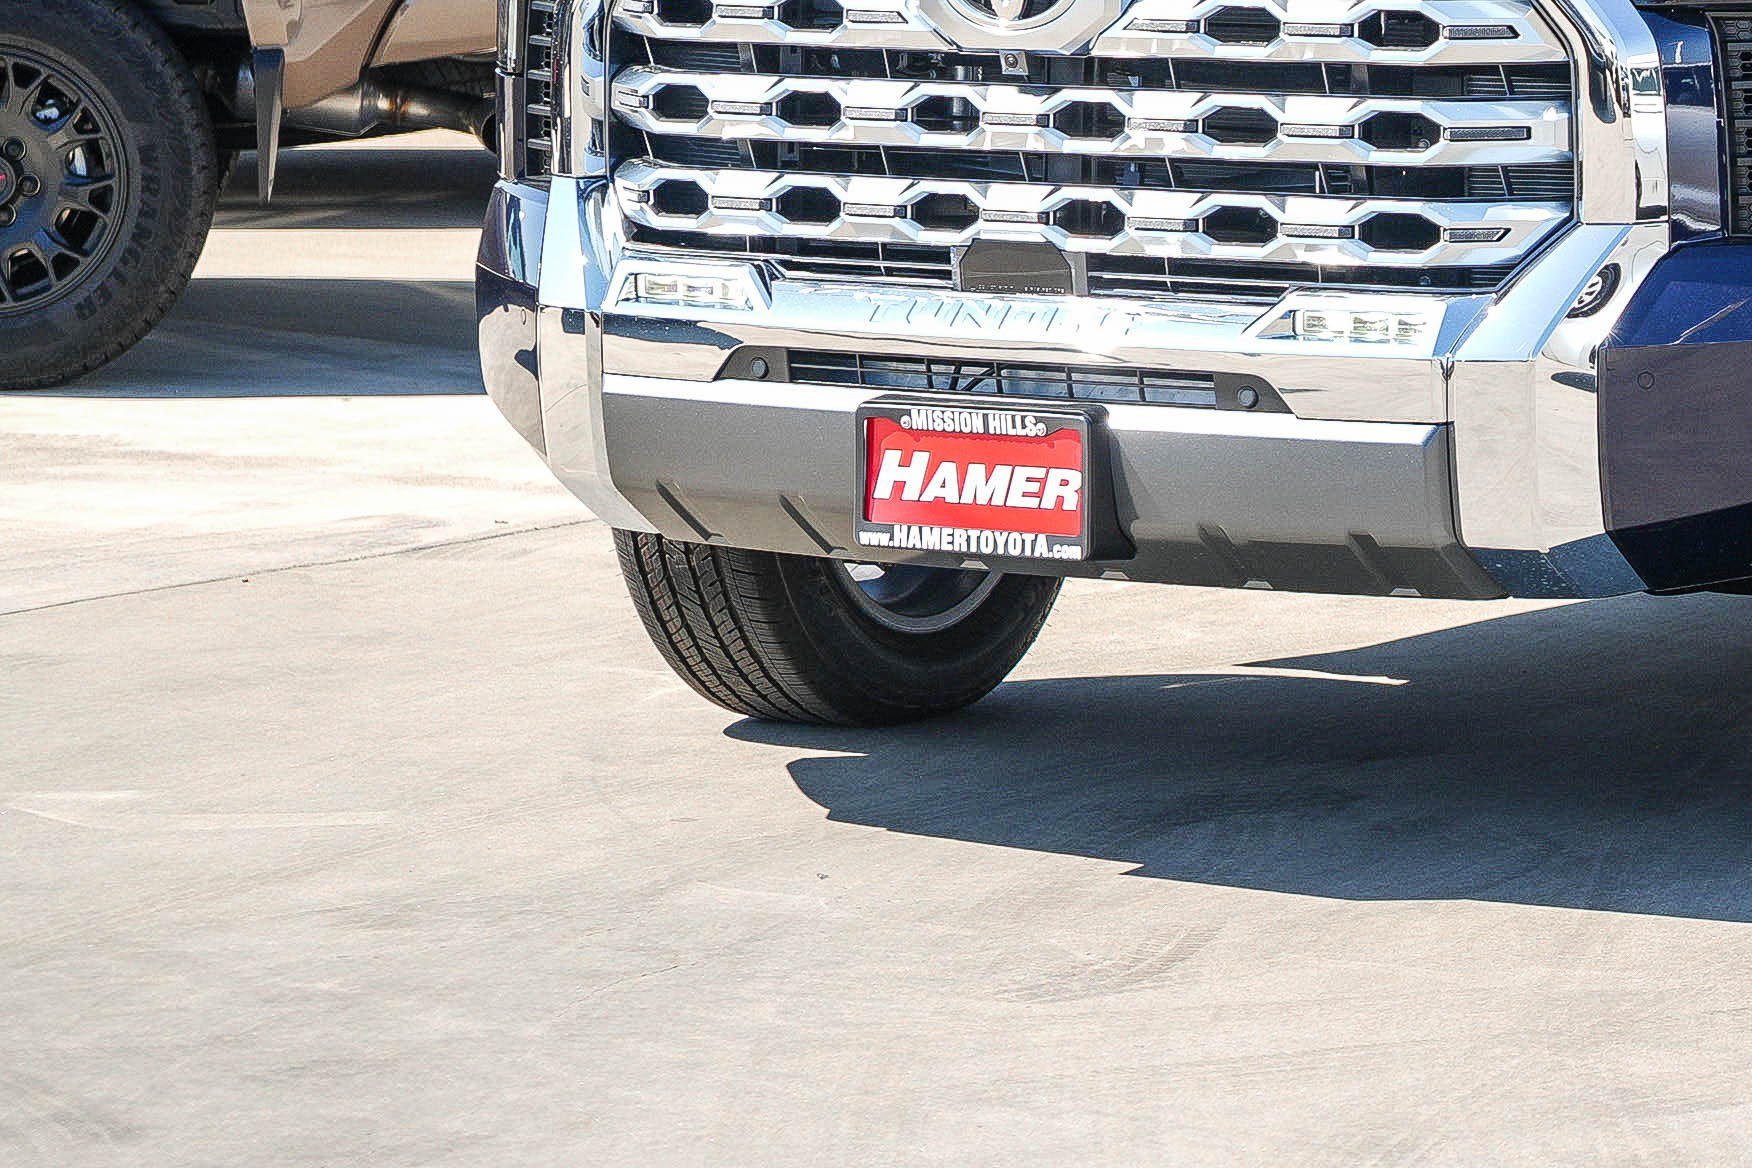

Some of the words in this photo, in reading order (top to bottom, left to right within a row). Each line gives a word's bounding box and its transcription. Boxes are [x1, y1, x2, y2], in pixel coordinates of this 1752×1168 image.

[865, 296, 1134, 338] TUND
[910, 408, 985, 434] MISSION
[989, 414, 1037, 437] HILLS
[873, 449, 1082, 510] HAMER
[859, 525, 1082, 560] www.HAMERTOYOTA.com
